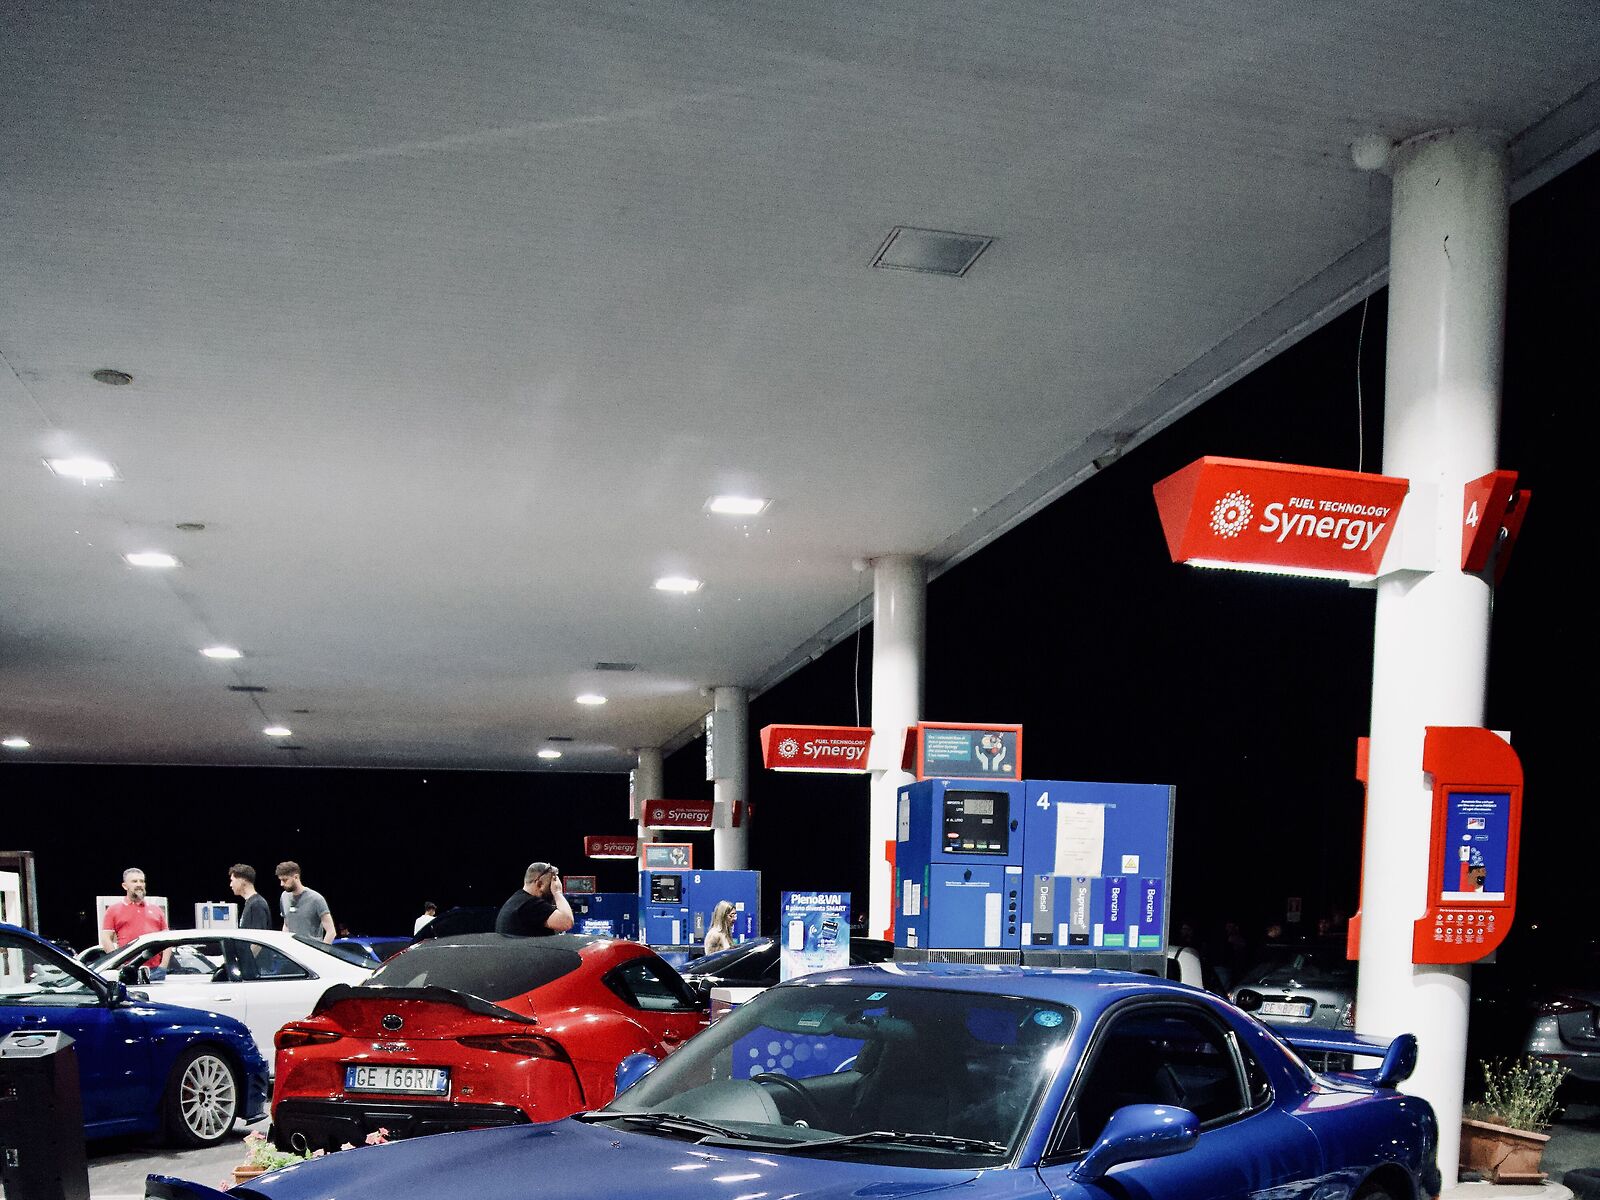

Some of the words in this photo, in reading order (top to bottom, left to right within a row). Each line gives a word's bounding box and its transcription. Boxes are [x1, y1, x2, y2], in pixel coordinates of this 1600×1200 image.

[1288, 497, 1315, 510] FUEL
[1318, 500, 1391, 518] TECHNOLOGY
[1465, 500, 1479, 528] 4
[1259, 502, 1386, 551] Synergy
[803, 741, 866, 760] Synergy
[1036, 791, 1051, 811] 4
[668, 810, 710, 822] Synergy
[603, 843, 635, 852] Synergy
[694, 874, 701, 884] 8
[1040, 886, 1049, 913] Diesel
[1111, 887, 1121, 922] Benzina
[1146, 888, 1156, 924] Benzina
[357, 1068, 378, 1087] GE
[385, 1069, 436, 1089] 166RW
